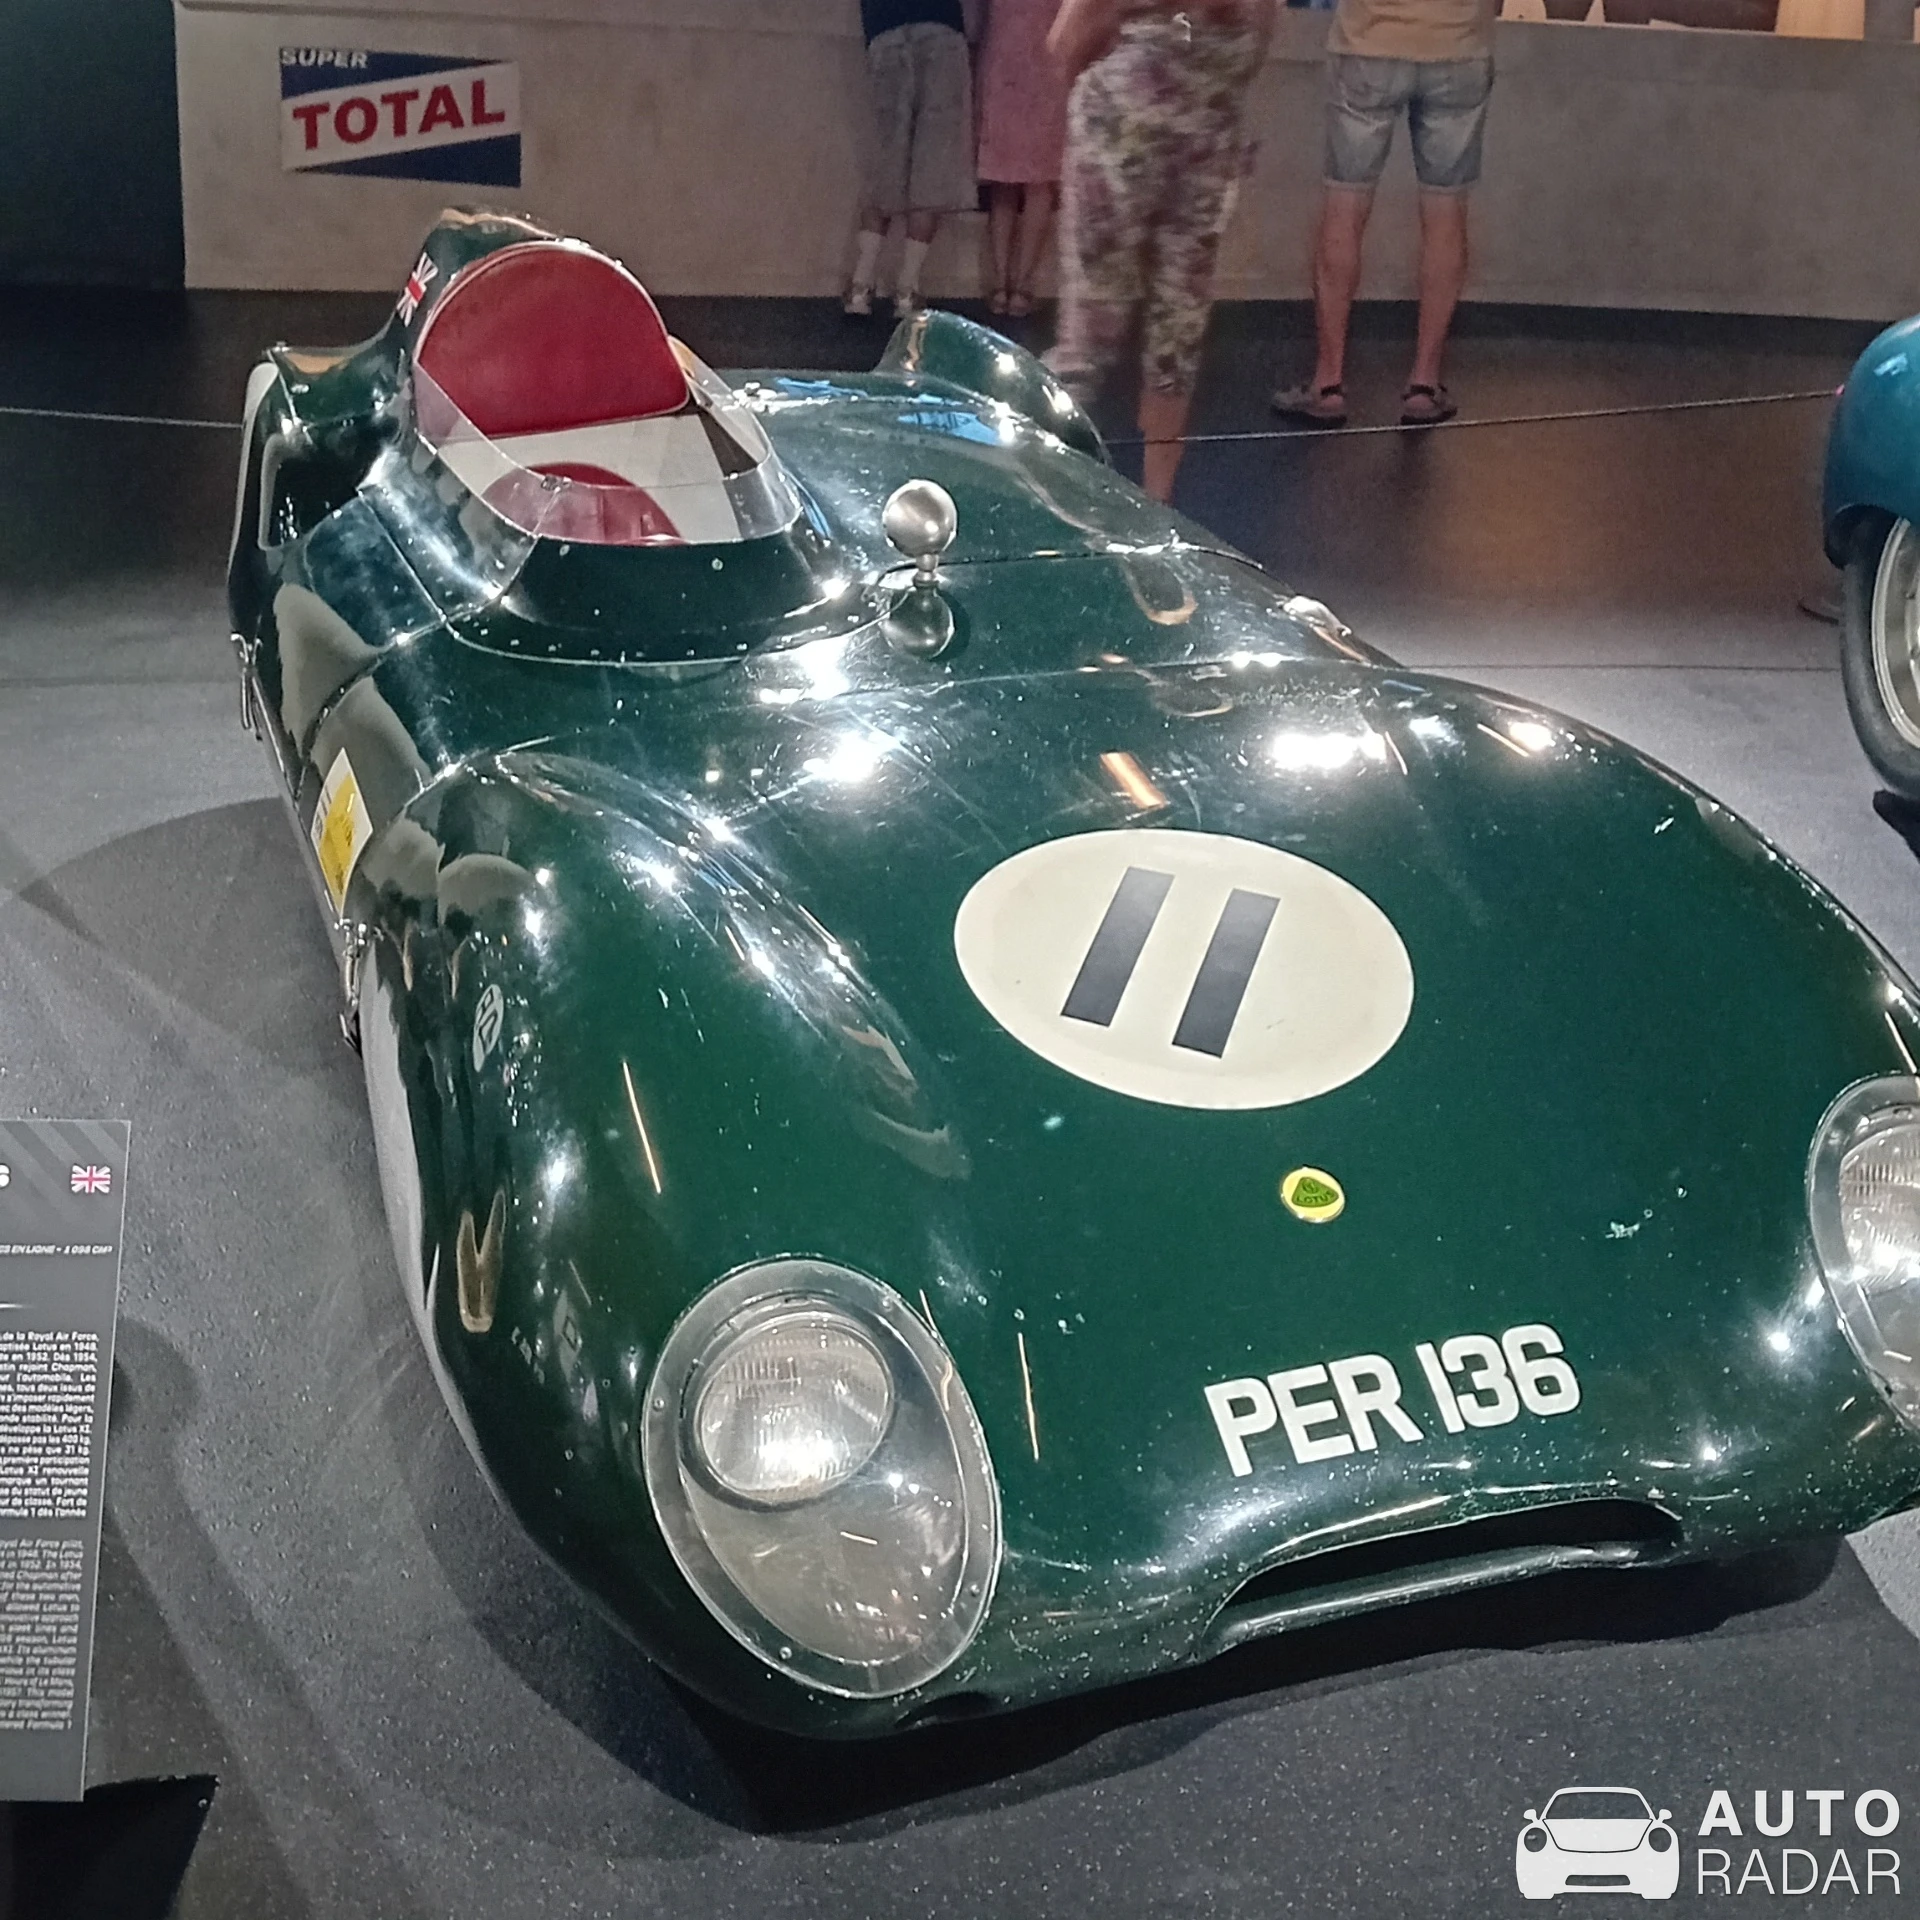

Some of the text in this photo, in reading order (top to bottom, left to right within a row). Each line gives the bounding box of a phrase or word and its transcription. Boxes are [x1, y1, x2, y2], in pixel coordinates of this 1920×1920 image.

[281, 49, 368, 69] SUPER
[292, 77, 506, 150] TOTAL
[1060, 865, 1281, 1058] 11
[1296, 1190, 1335, 1204] LOTUS
[28, 1331, 54, 1342] Royal
[56, 1331, 69, 1340] Air
[72, 1331, 99, 1342] Force,
[0, 1342, 30, 1352] aptisée
[32, 1342, 57, 1351] Lotus
[19, 1363, 48, 1373] rejoint
[80, 1374, 96, 1382] Les
[16, 1384, 36, 1392] tous
[38, 1384, 58, 1392] deux
[60, 1384, 82, 1392] issus
[48, 1394, 94, 1404] rapidement
[1204, 1323, 1581, 1477] PER 136
[12, 1404, 26, 1412] des
[62, 1414, 82, 1423] Pour
[53, 1425, 77, 1434] Lotus
[32, 1435, 46, 1444] pas
[46, 1446, 62, 1455] que
[40, 1456, 90, 1465] participation
[42, 1466, 90, 1475] renouvelle
[35, 1478, 48, 1486] un
[50, 1478, 88, 1486] tournant
[24, 1488, 50, 1496] statut
[64, 1488, 88, 1498] jeune
[56, 1498, 74, 1506] Fort
[16, 1572, 58, 1580] Chapman
